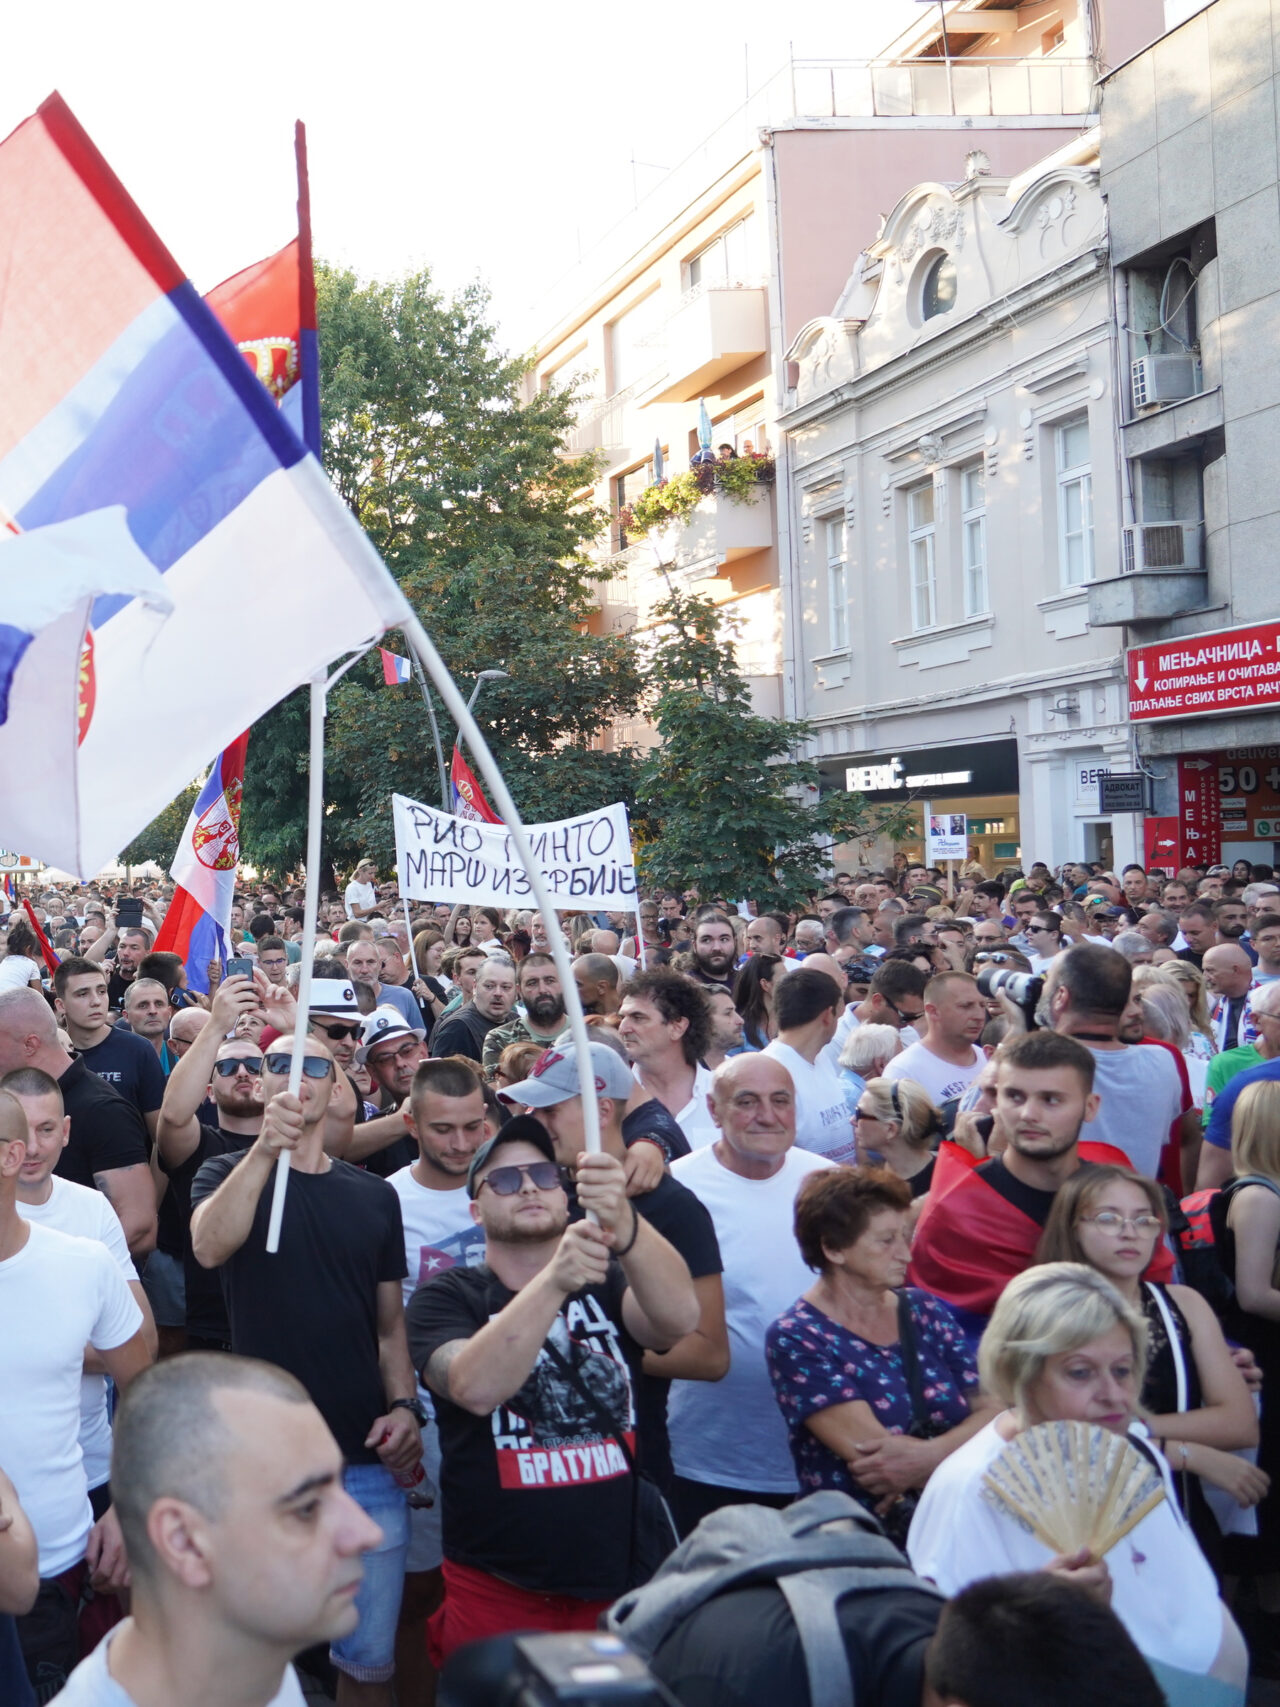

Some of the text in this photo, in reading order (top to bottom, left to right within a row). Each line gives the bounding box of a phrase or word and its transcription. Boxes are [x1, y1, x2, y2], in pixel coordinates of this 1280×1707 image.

[1159, 640, 1262, 672] МЕЊАЧНИЦА
[1154, 672, 1214, 691] КОПИРАЊЕ
[1218, 670, 1225, 682] И
[1129, 695, 1182, 712] ПЛАЋАЊЕ
[1185, 690, 1214, 705] СВИХ
[1218, 685, 1254, 701] ВРСТА
[1104, 783, 1140, 792] АДВОКАТ
[1218, 766, 1257, 792] 50
[407, 806, 483, 851] РИО
[406, 852, 487, 888] МАРШ
